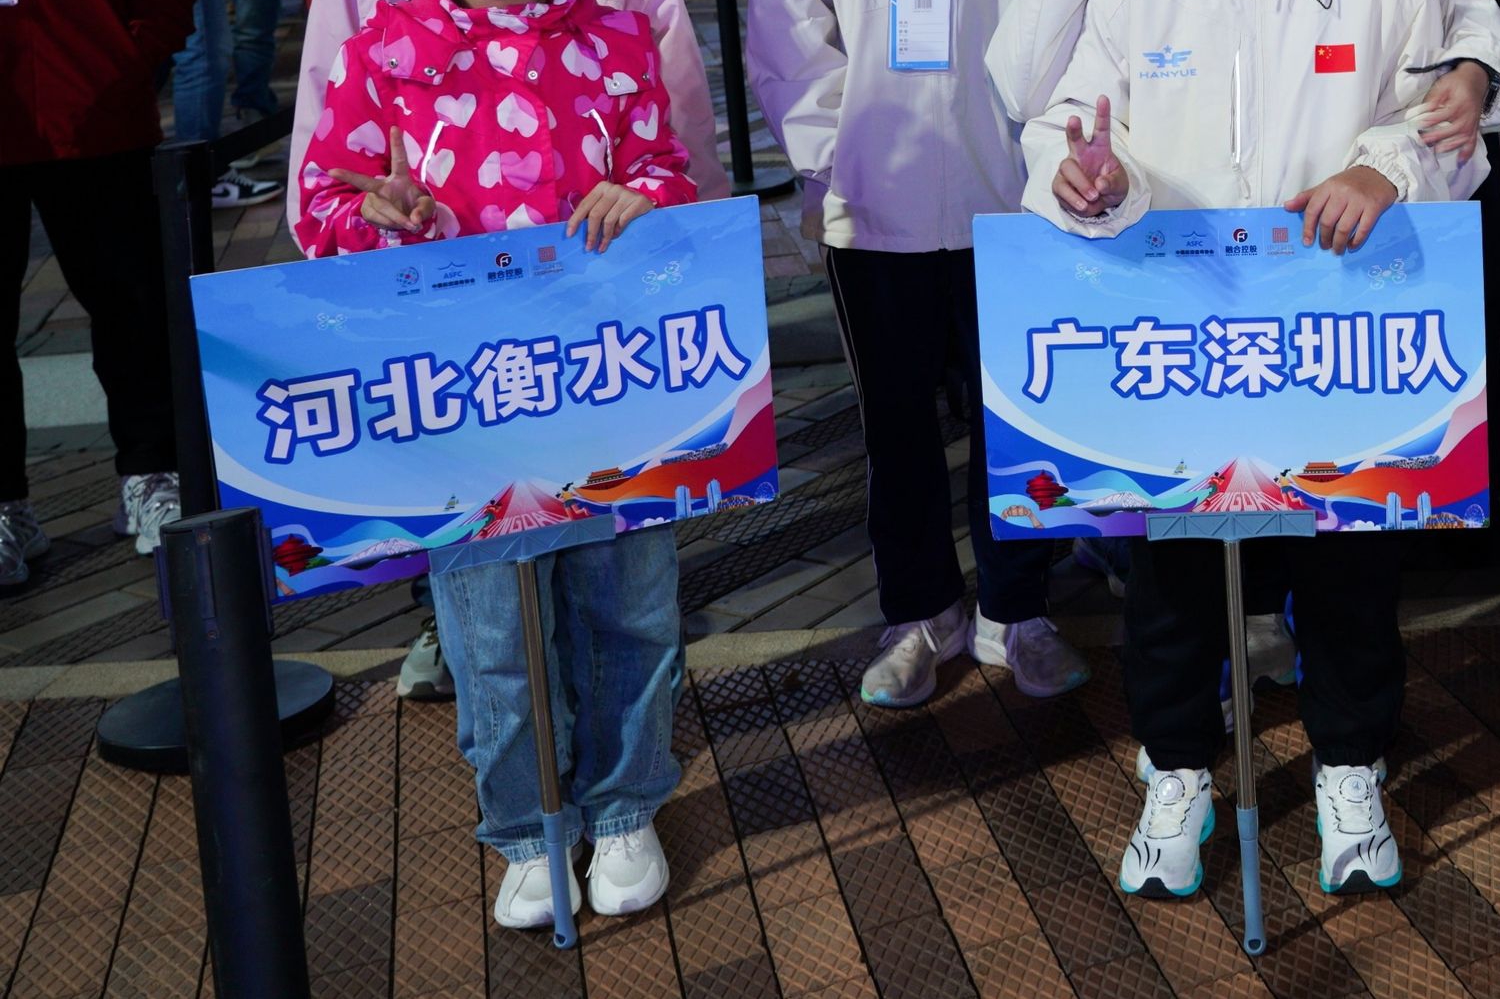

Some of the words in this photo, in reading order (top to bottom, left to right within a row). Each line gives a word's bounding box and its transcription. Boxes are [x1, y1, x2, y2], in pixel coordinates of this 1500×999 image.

[1139, 67, 1198, 80] HANYUE
[1225, 245, 1258, 254] 融合控股
[443, 270, 463, 280] ASFC
[487, 267, 523, 281] 融合控股
[1023, 310, 1467, 402] 广东深圳队
[257, 305, 750, 465] 河北衡水队
